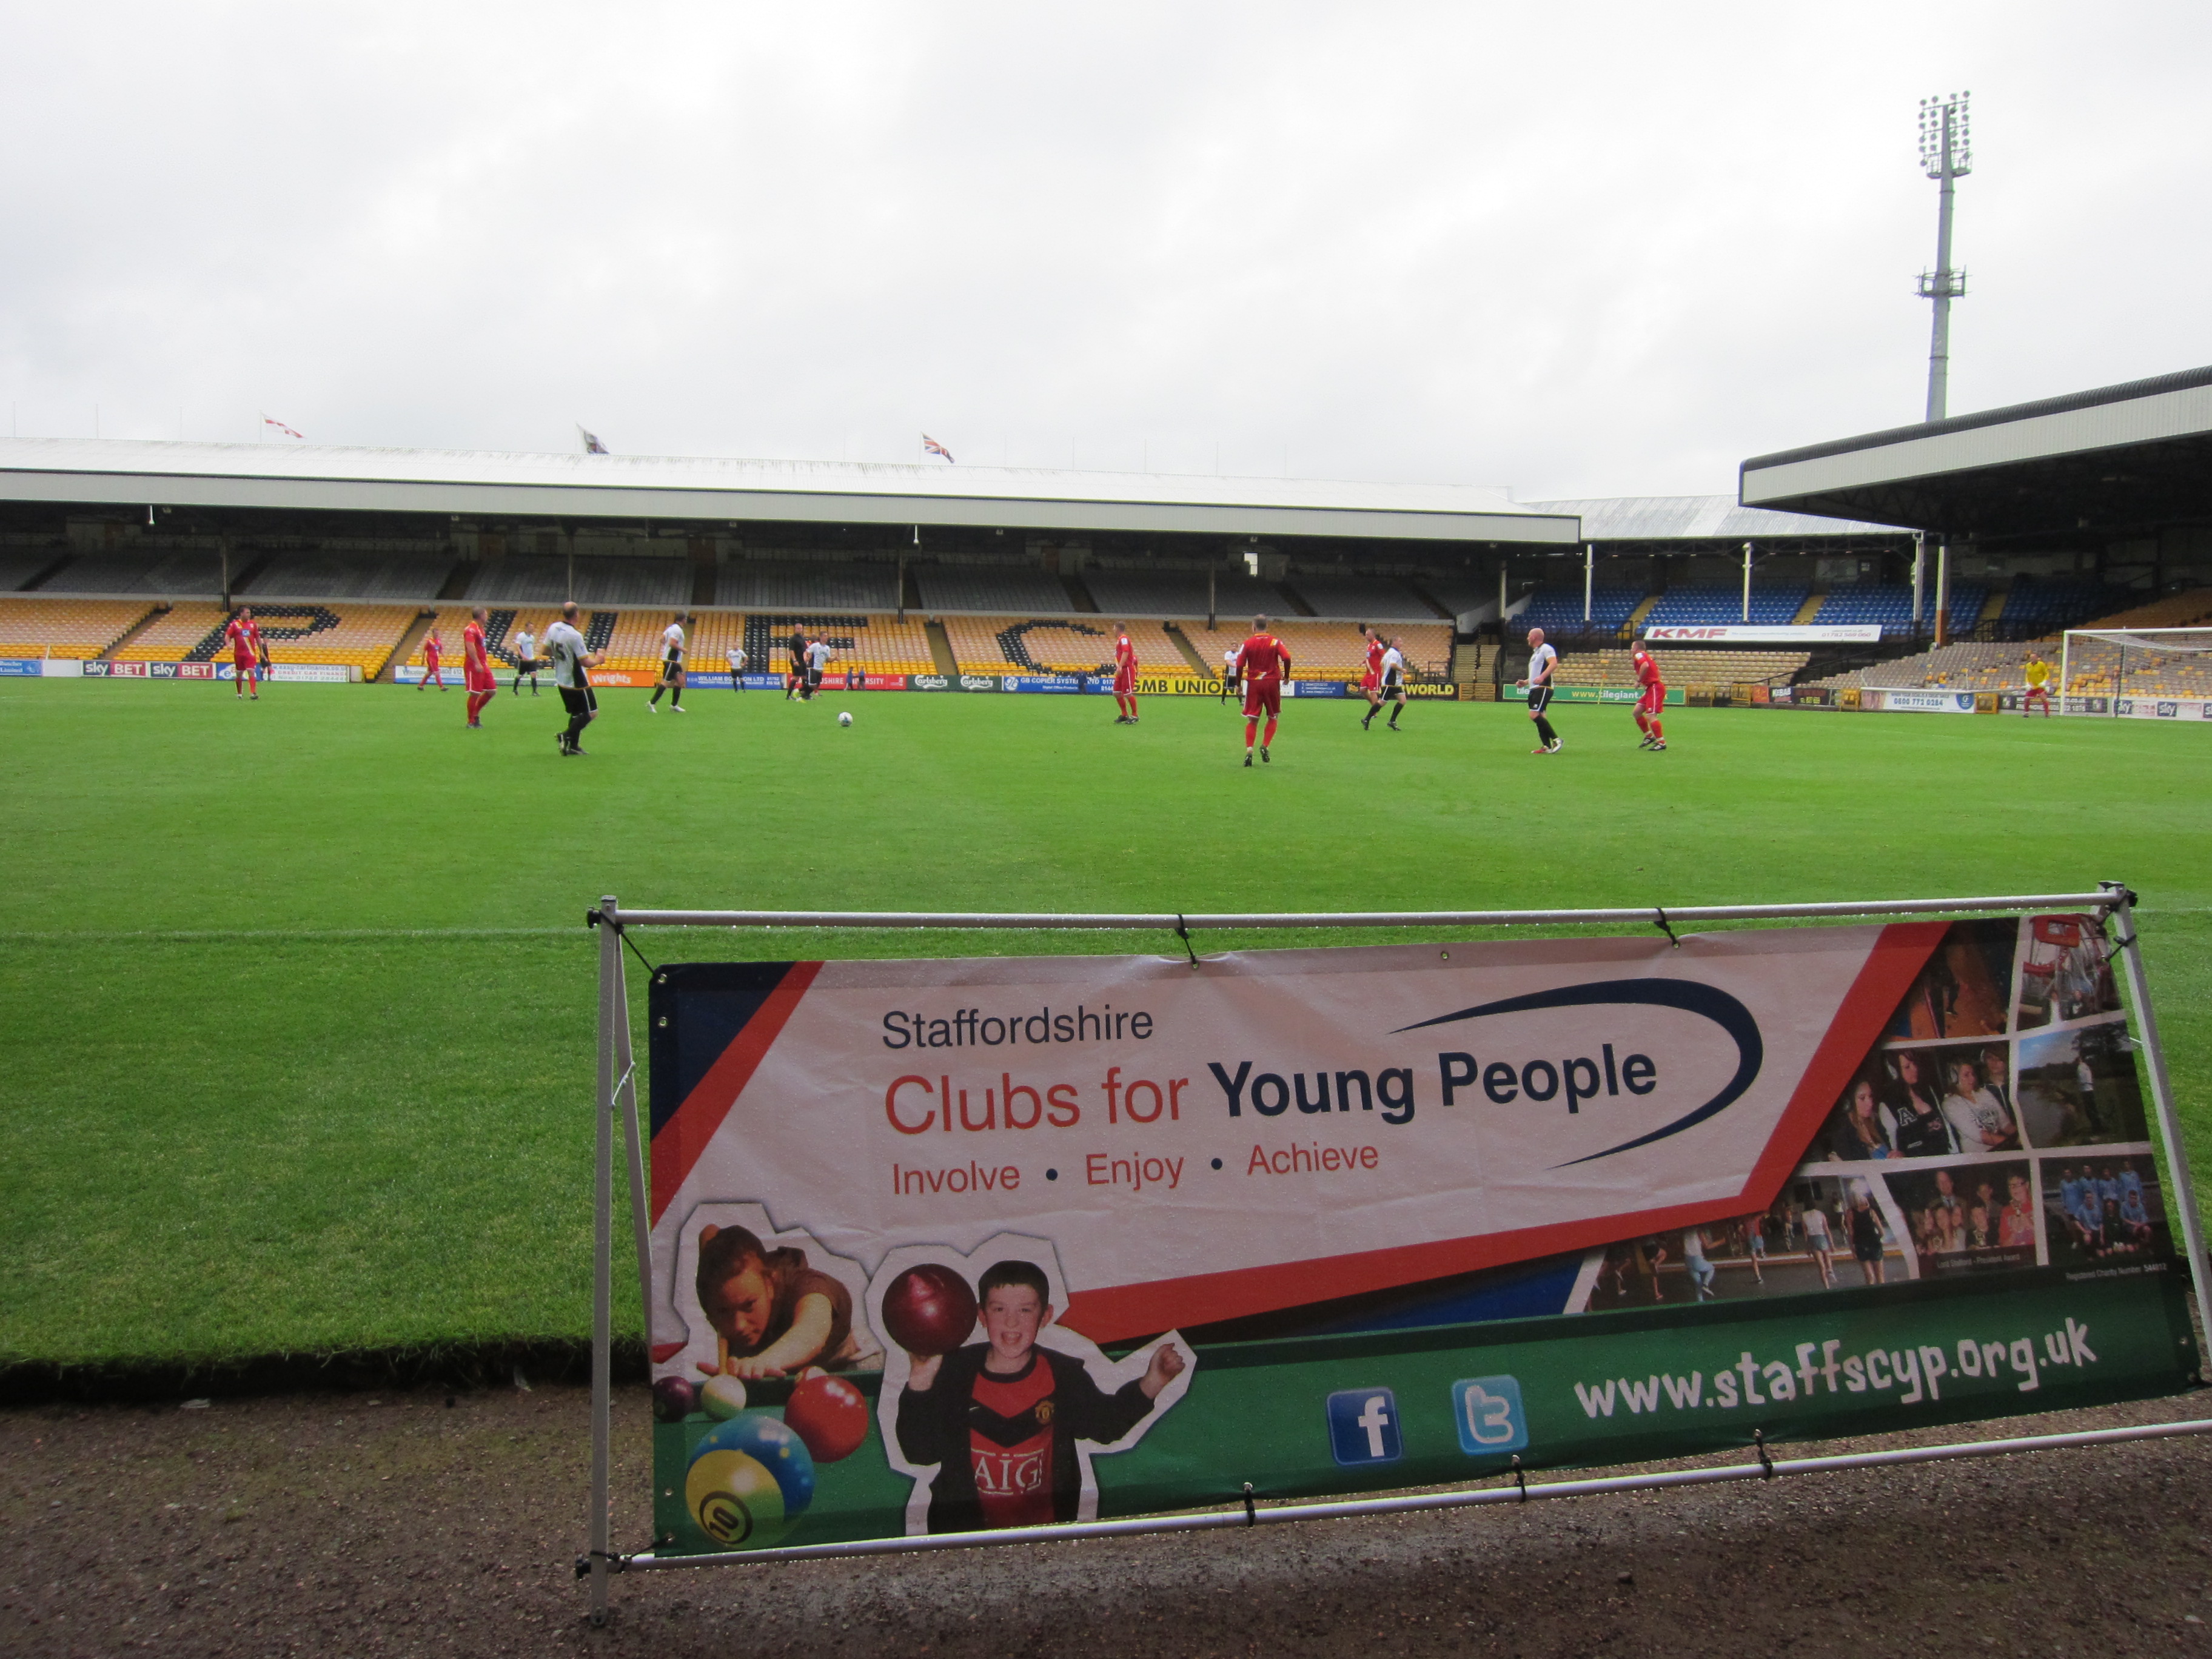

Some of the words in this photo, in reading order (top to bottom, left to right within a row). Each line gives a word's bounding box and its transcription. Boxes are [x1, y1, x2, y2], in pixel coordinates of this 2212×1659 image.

[1652, 628, 1728, 638] KMF
[85, 662, 108, 676] sky
[114, 663, 142, 675] BET
[153, 665, 176, 677] sky
[182, 665, 209, 676] BET
[591, 673, 632, 684] Wrights
[914, 675, 948, 687] Carlsberg
[960, 675, 993, 688] Carlsberg
[2158, 703, 2176, 716] sky
[883, 1004, 1153, 1049] Staffordshire
[885, 1072, 1081, 1134] Clubs
[1101, 1067, 1188, 1124] for
[1207, 1061, 1416, 1125] Young
[1438, 1043, 1657, 1114] People
[893, 1160, 1020, 1195] Involve
[1086, 1151, 1184, 1191] Enjoy
[1247, 1142, 1378, 1176] Achieve
[2096, 1269, 2117, 1277] Charity
[2117, 1266, 2142, 1275] Number
[1574, 1317, 2097, 1419] www.staffscyp.org.uk
[974, 1456, 1039, 1490] AIG
[708, 1506, 739, 1538] 10
